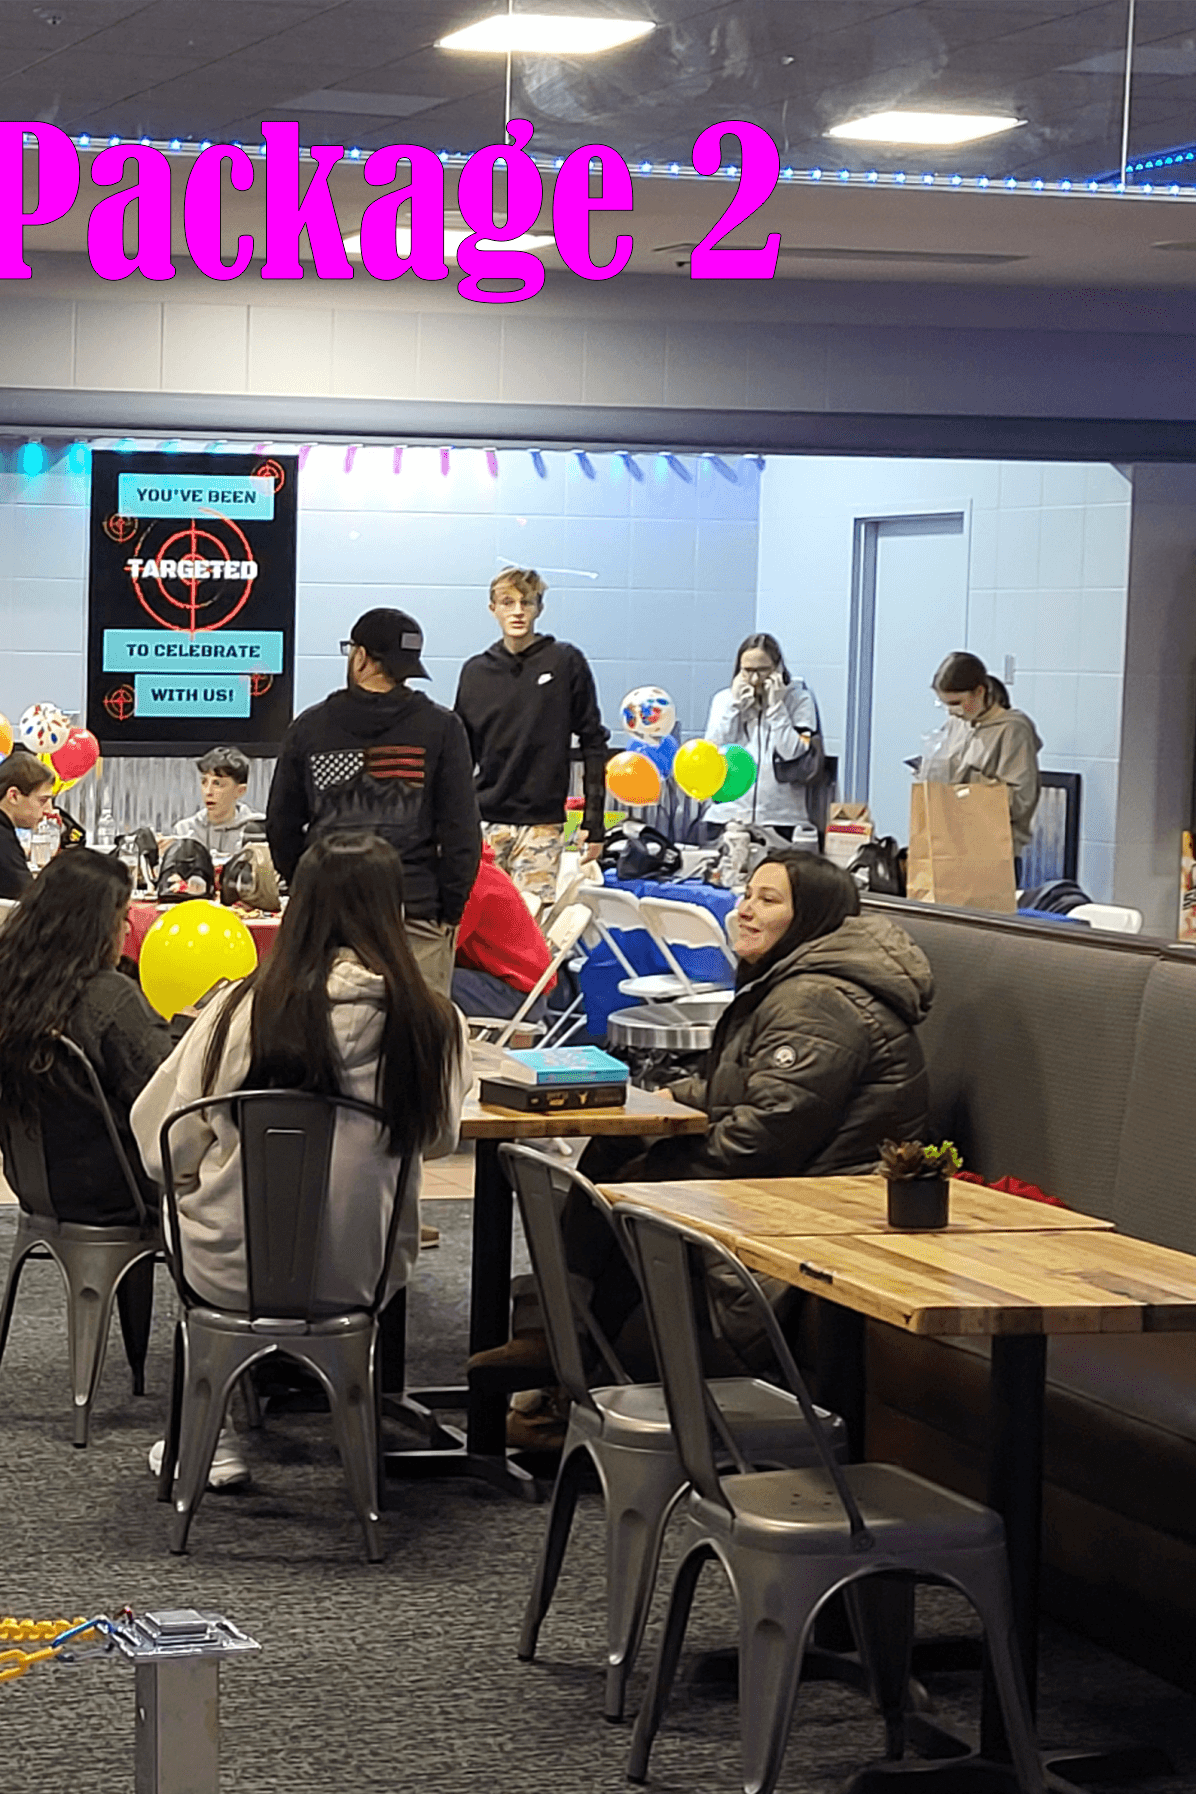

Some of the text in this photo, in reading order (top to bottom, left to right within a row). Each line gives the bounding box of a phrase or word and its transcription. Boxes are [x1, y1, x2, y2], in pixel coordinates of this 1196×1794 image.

[137, 488, 256, 503] YOU'VE BEEN
[127, 558, 258, 580] TARGETED
[126, 643, 261, 658] TO CELEBRATE
[151, 688, 234, 702] WITH US!
